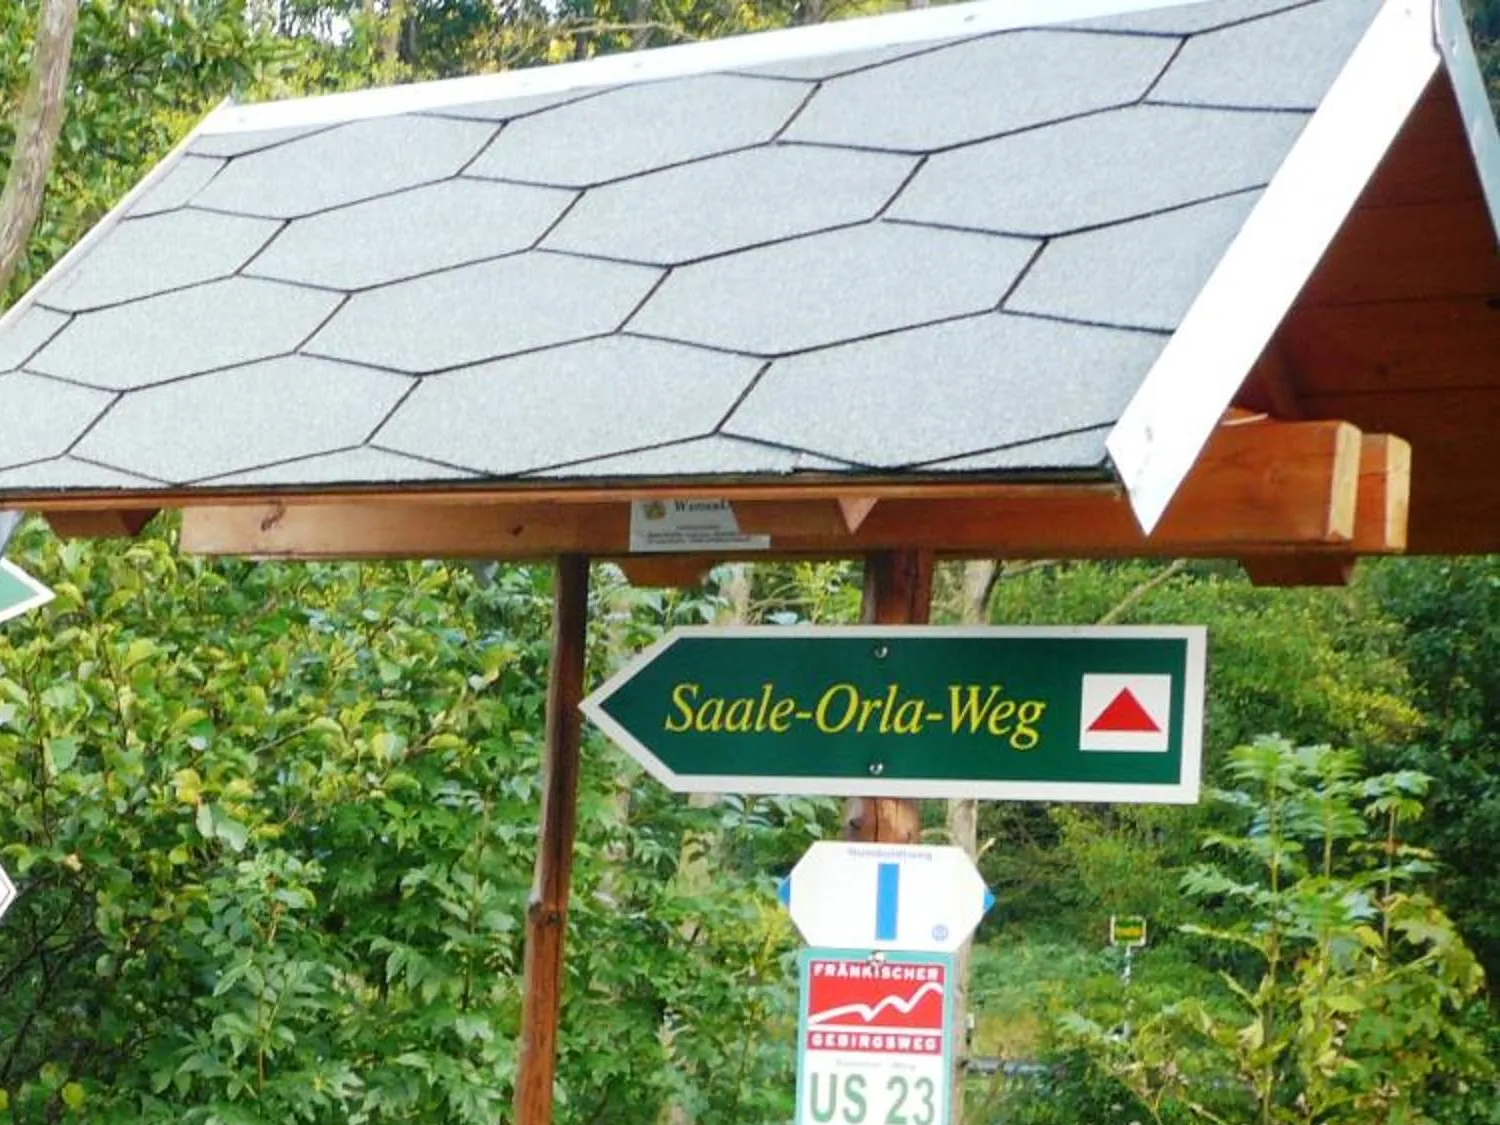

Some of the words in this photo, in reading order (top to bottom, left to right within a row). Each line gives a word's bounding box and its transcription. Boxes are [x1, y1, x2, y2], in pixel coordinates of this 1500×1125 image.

[664, 683, 1047, 751] Saale-Orla-Weg
[813, 962, 939, 981] FRÄNKISCHER
[811, 1032, 937, 1051] GEBIRGSWEG
[810, 1072, 867, 1125] US
